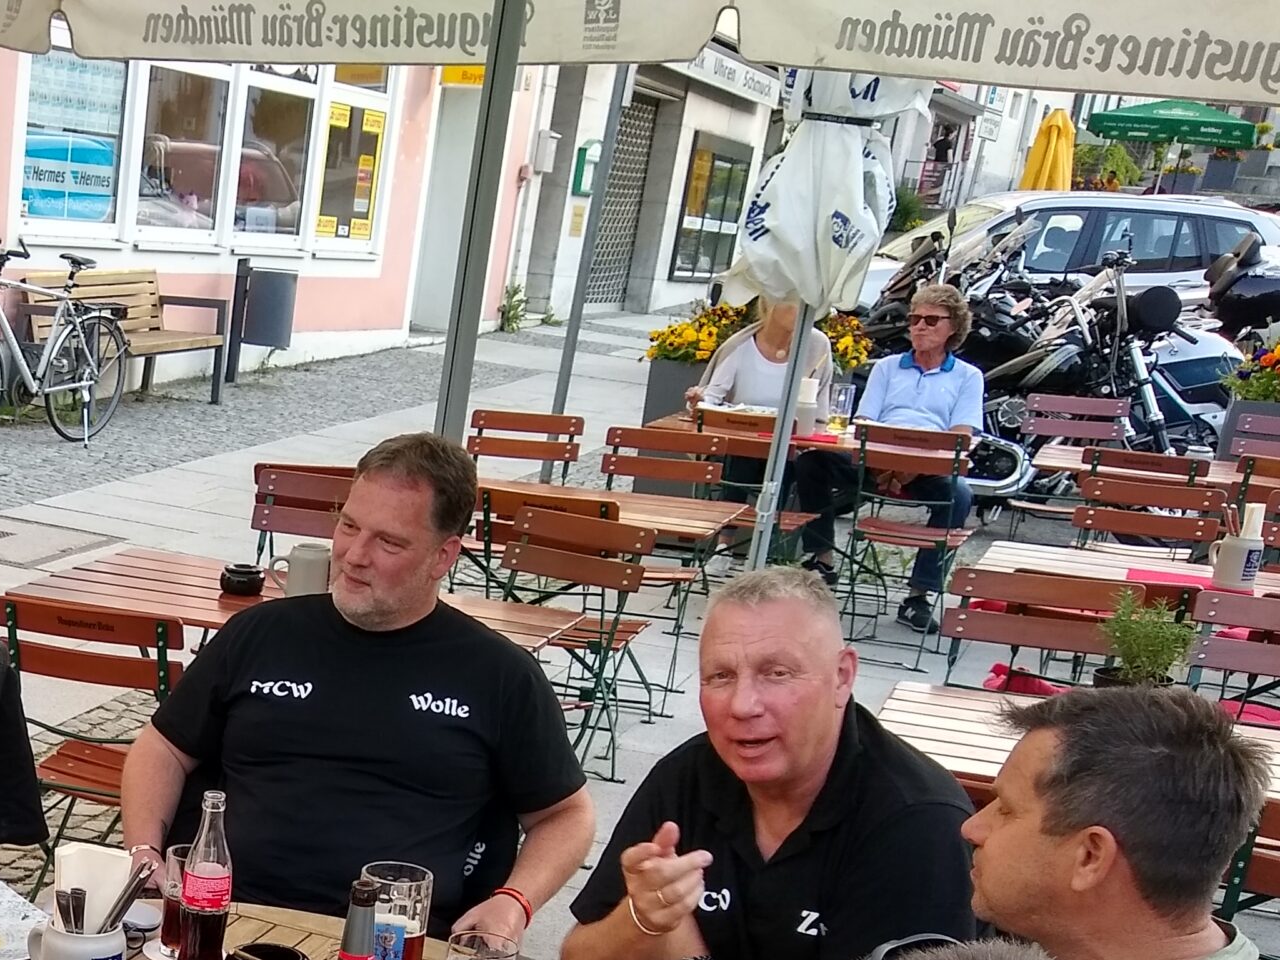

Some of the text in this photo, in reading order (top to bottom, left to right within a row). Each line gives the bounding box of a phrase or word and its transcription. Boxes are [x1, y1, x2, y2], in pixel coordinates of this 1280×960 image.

[713, 58, 737, 82] Uhren
[742, 71, 773, 97] Schmuck
[32, 165, 66, 183] Hermes
[79, 171, 111, 188] Hermes
[250, 680, 313, 699] MCW
[409, 692, 470, 718] Wolle
